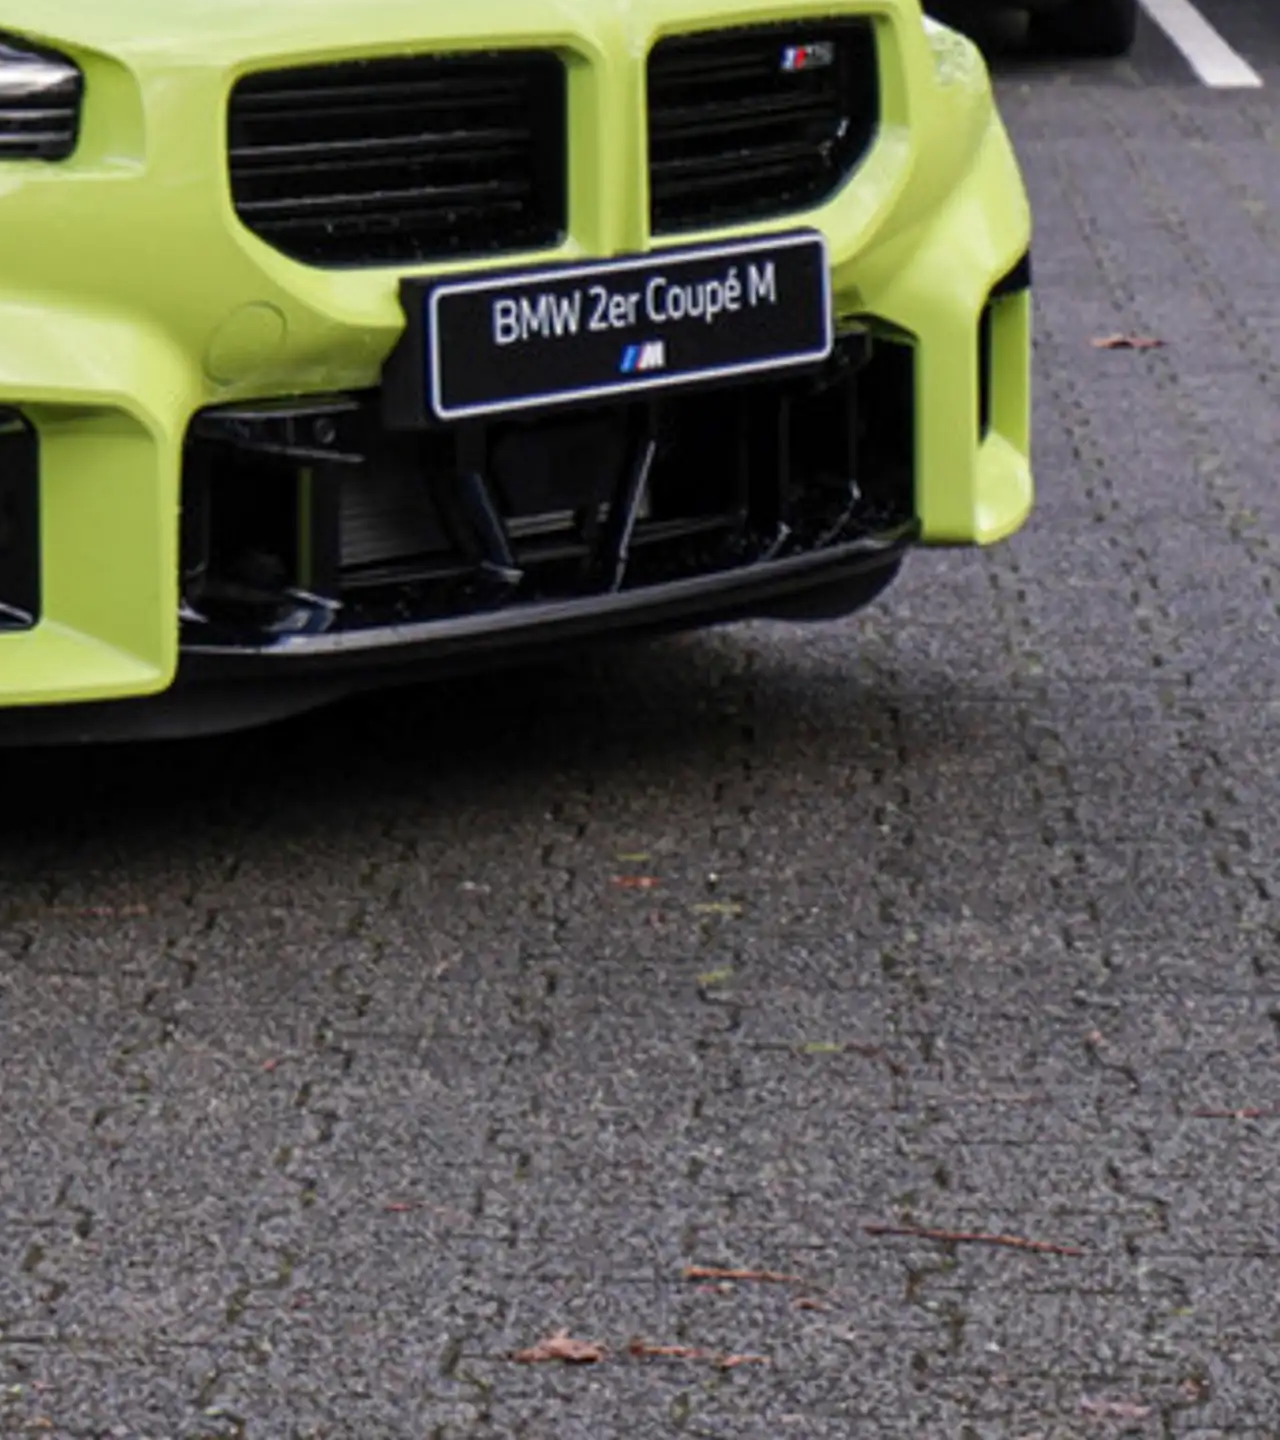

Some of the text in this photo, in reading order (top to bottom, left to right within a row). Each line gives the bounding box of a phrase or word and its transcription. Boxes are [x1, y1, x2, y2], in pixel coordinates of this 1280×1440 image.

[493, 262, 776, 345] BMW 2er Coupé M
